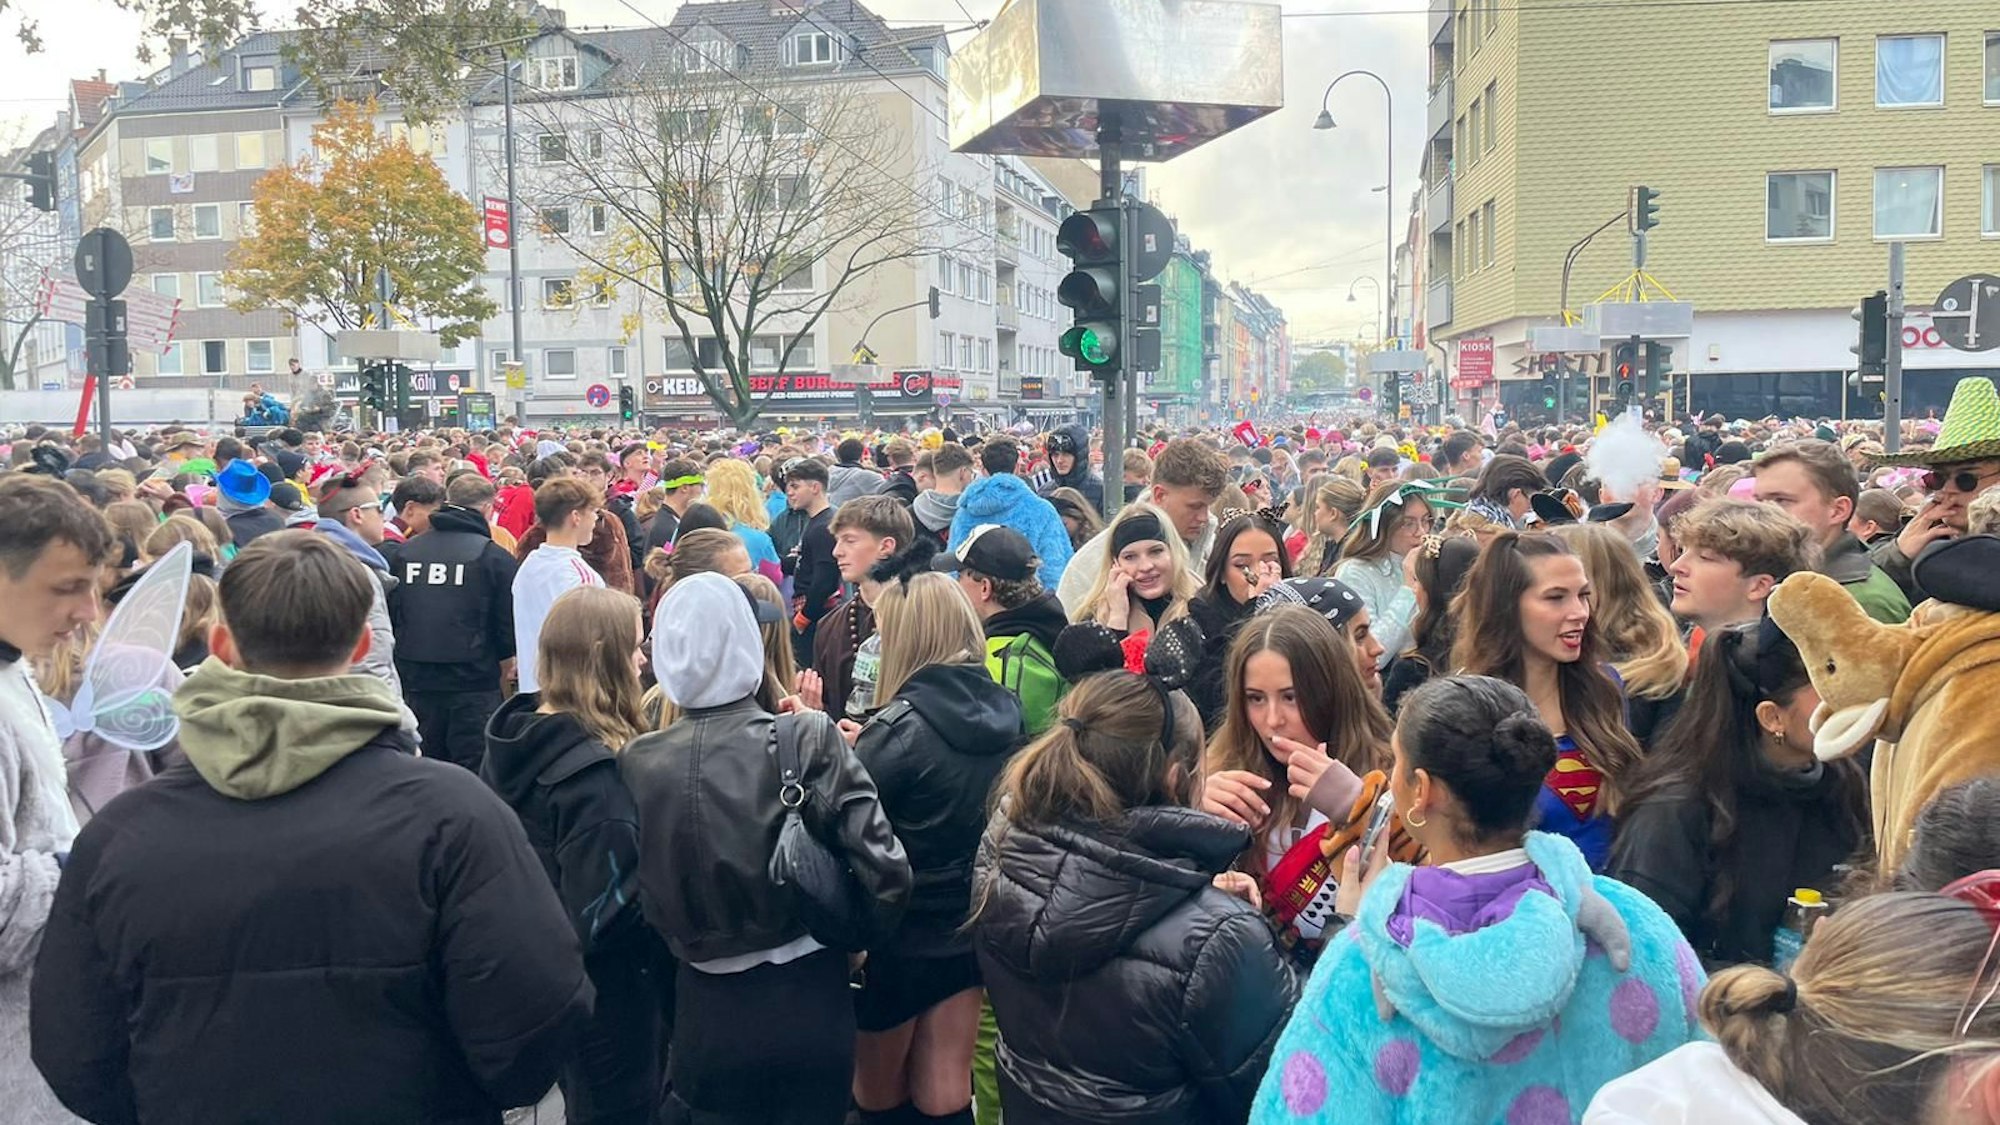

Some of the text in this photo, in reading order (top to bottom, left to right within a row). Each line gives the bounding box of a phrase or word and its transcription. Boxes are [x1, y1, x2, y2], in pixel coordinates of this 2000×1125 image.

[1461, 342, 1491, 352] KIOSK
[1512, 352, 1607, 375] SHTY
[410, 373, 437, 391] Köln
[663, 377, 706, 395] KEBA
[406, 562, 464, 585] FBI
